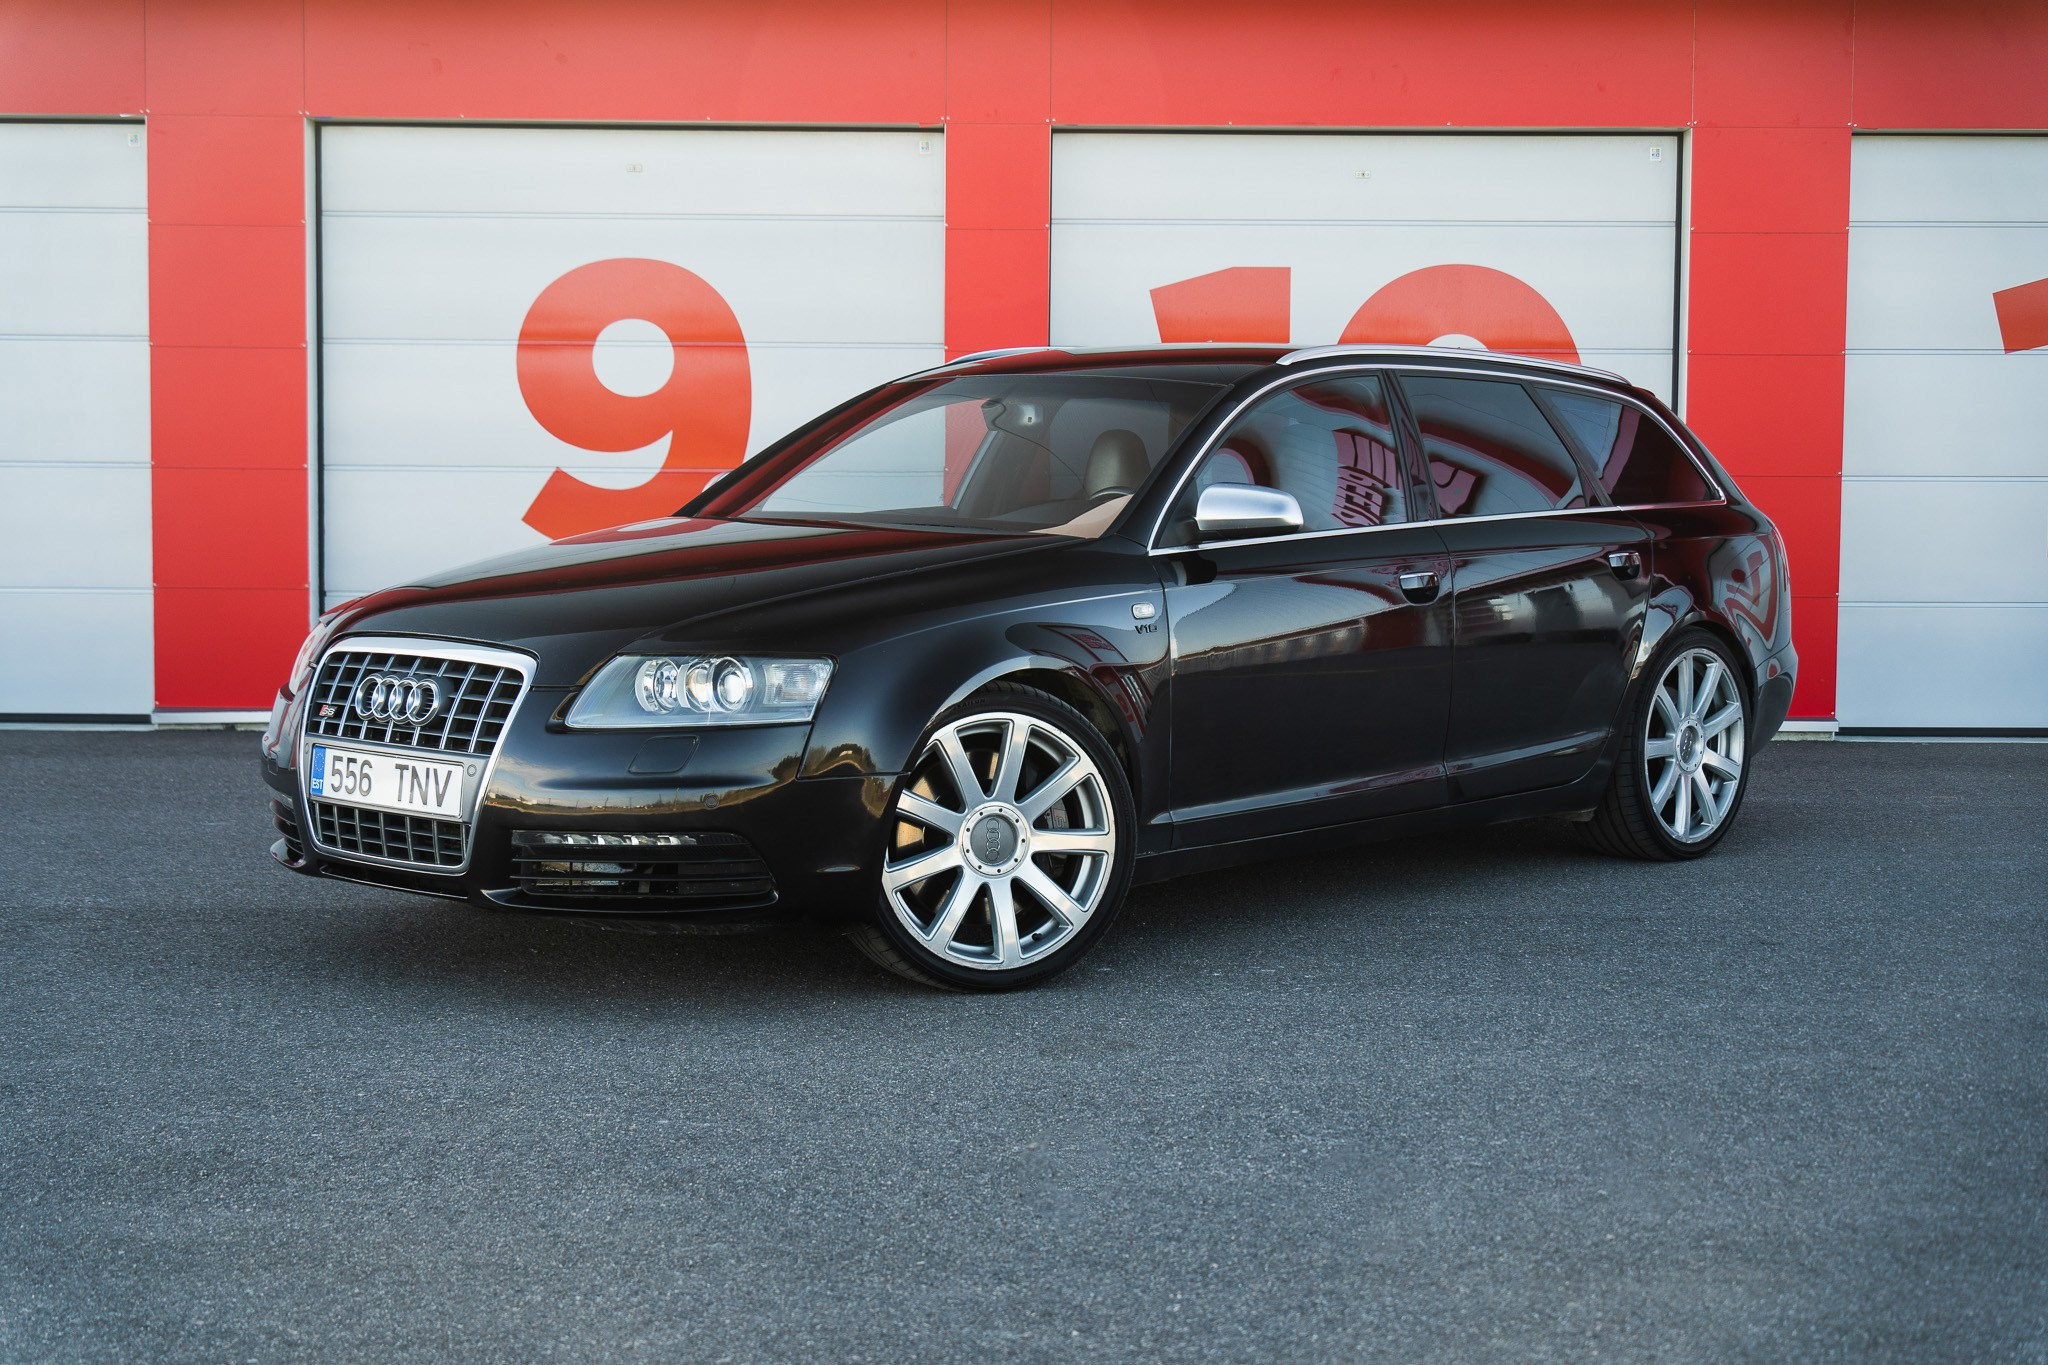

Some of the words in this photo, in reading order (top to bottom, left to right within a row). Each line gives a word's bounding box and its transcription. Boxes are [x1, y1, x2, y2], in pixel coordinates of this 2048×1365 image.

[516, 257, 752, 541] 9
[312, 778, 324, 790] EST
[331, 755, 373, 797] 556
[395, 763, 453, 807] TNV
